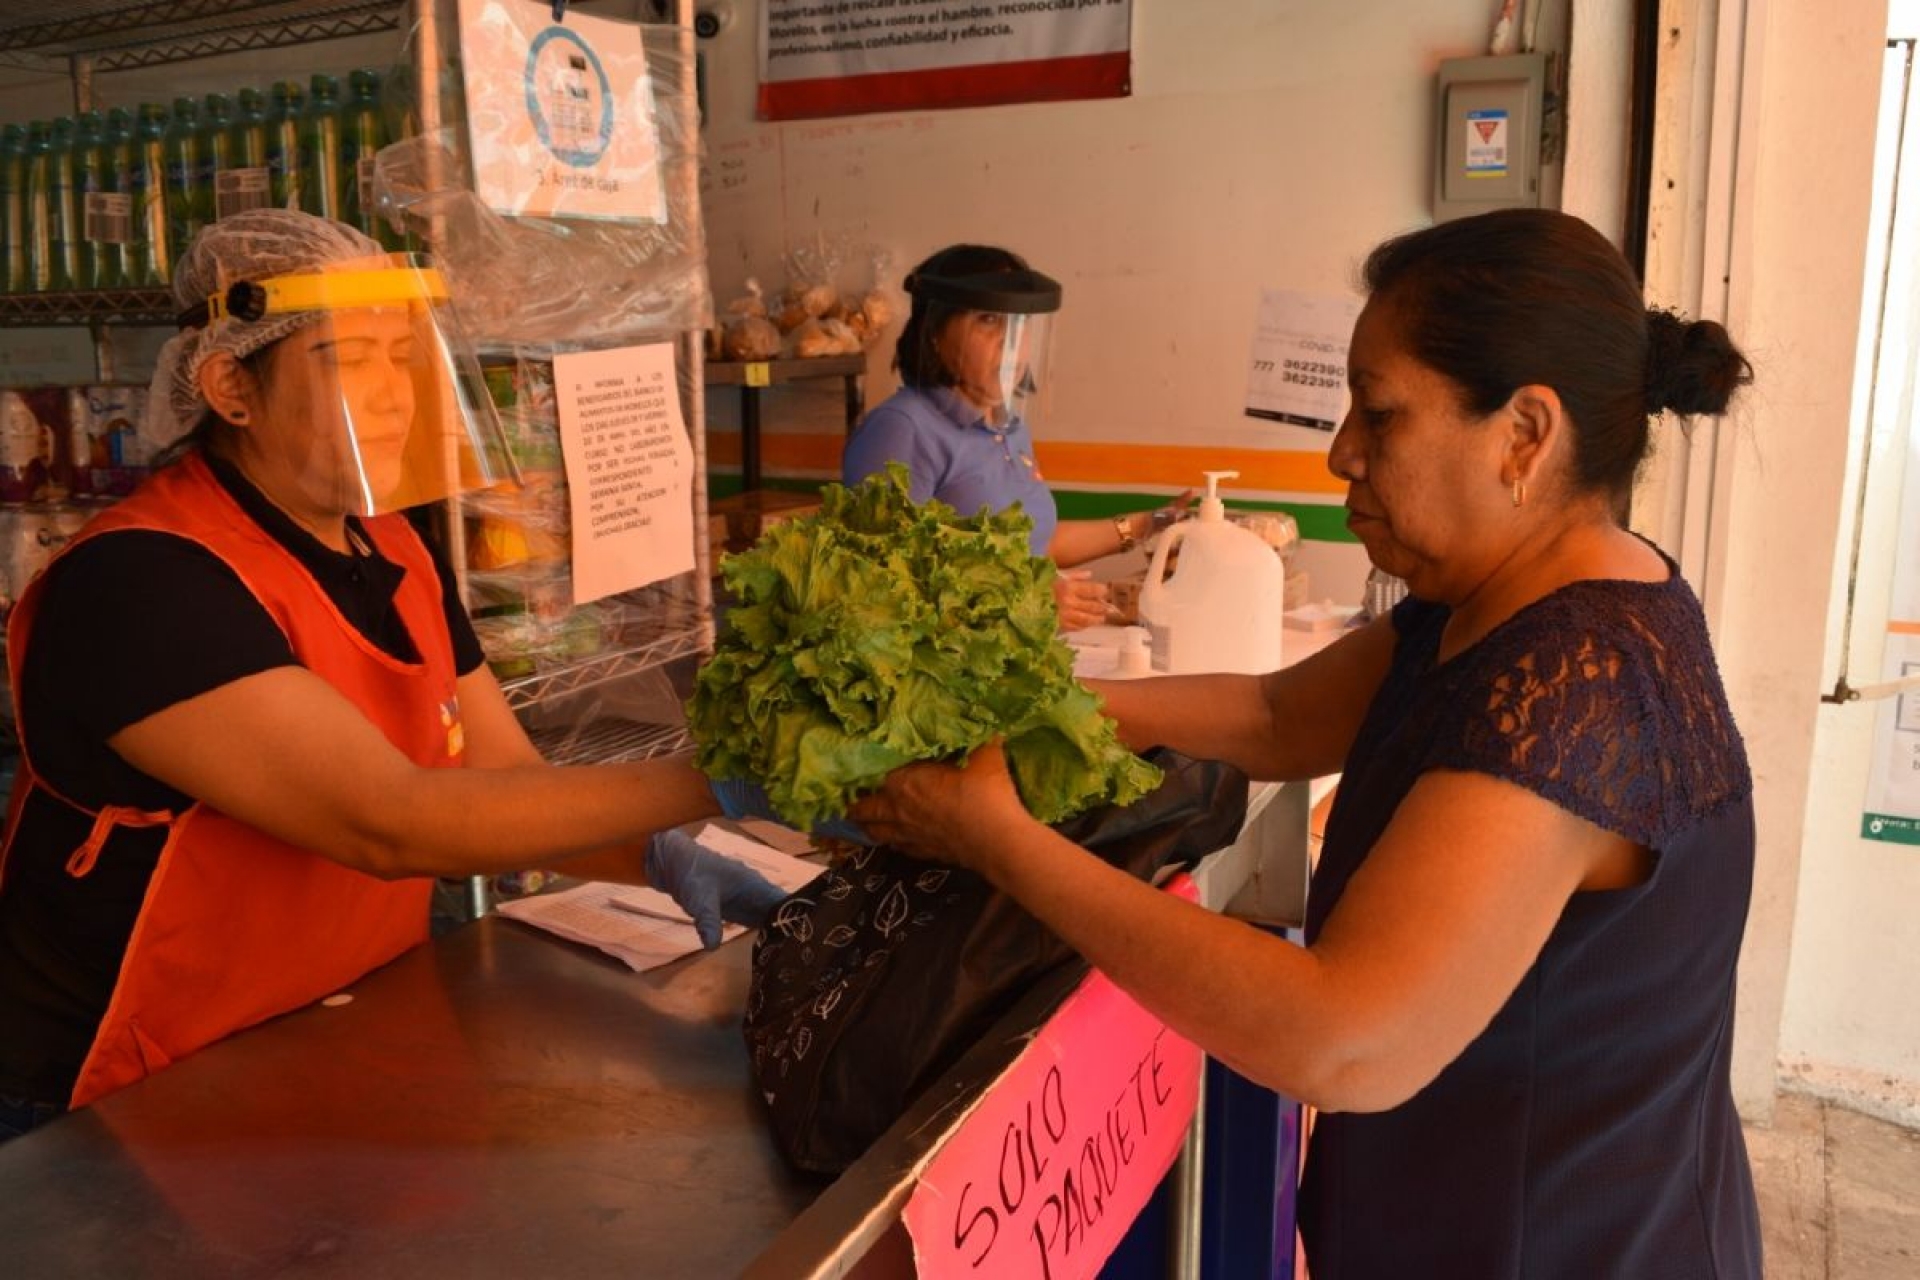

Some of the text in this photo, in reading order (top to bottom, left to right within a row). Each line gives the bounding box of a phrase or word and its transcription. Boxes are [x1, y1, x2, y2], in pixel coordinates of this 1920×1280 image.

[850, 16, 881, 30] lucha
[885, 12, 925, 26] contra
[928, 9, 939, 23] el
[942, 4, 995, 22] hambre,
[865, 27, 948, 49] confiabilidad
[951, 29, 961, 44] y
[1254, 360, 1275, 371] 777
[954, 1064, 1067, 1268] SOLO
[1030, 1026, 1173, 1280] PAQUETE
